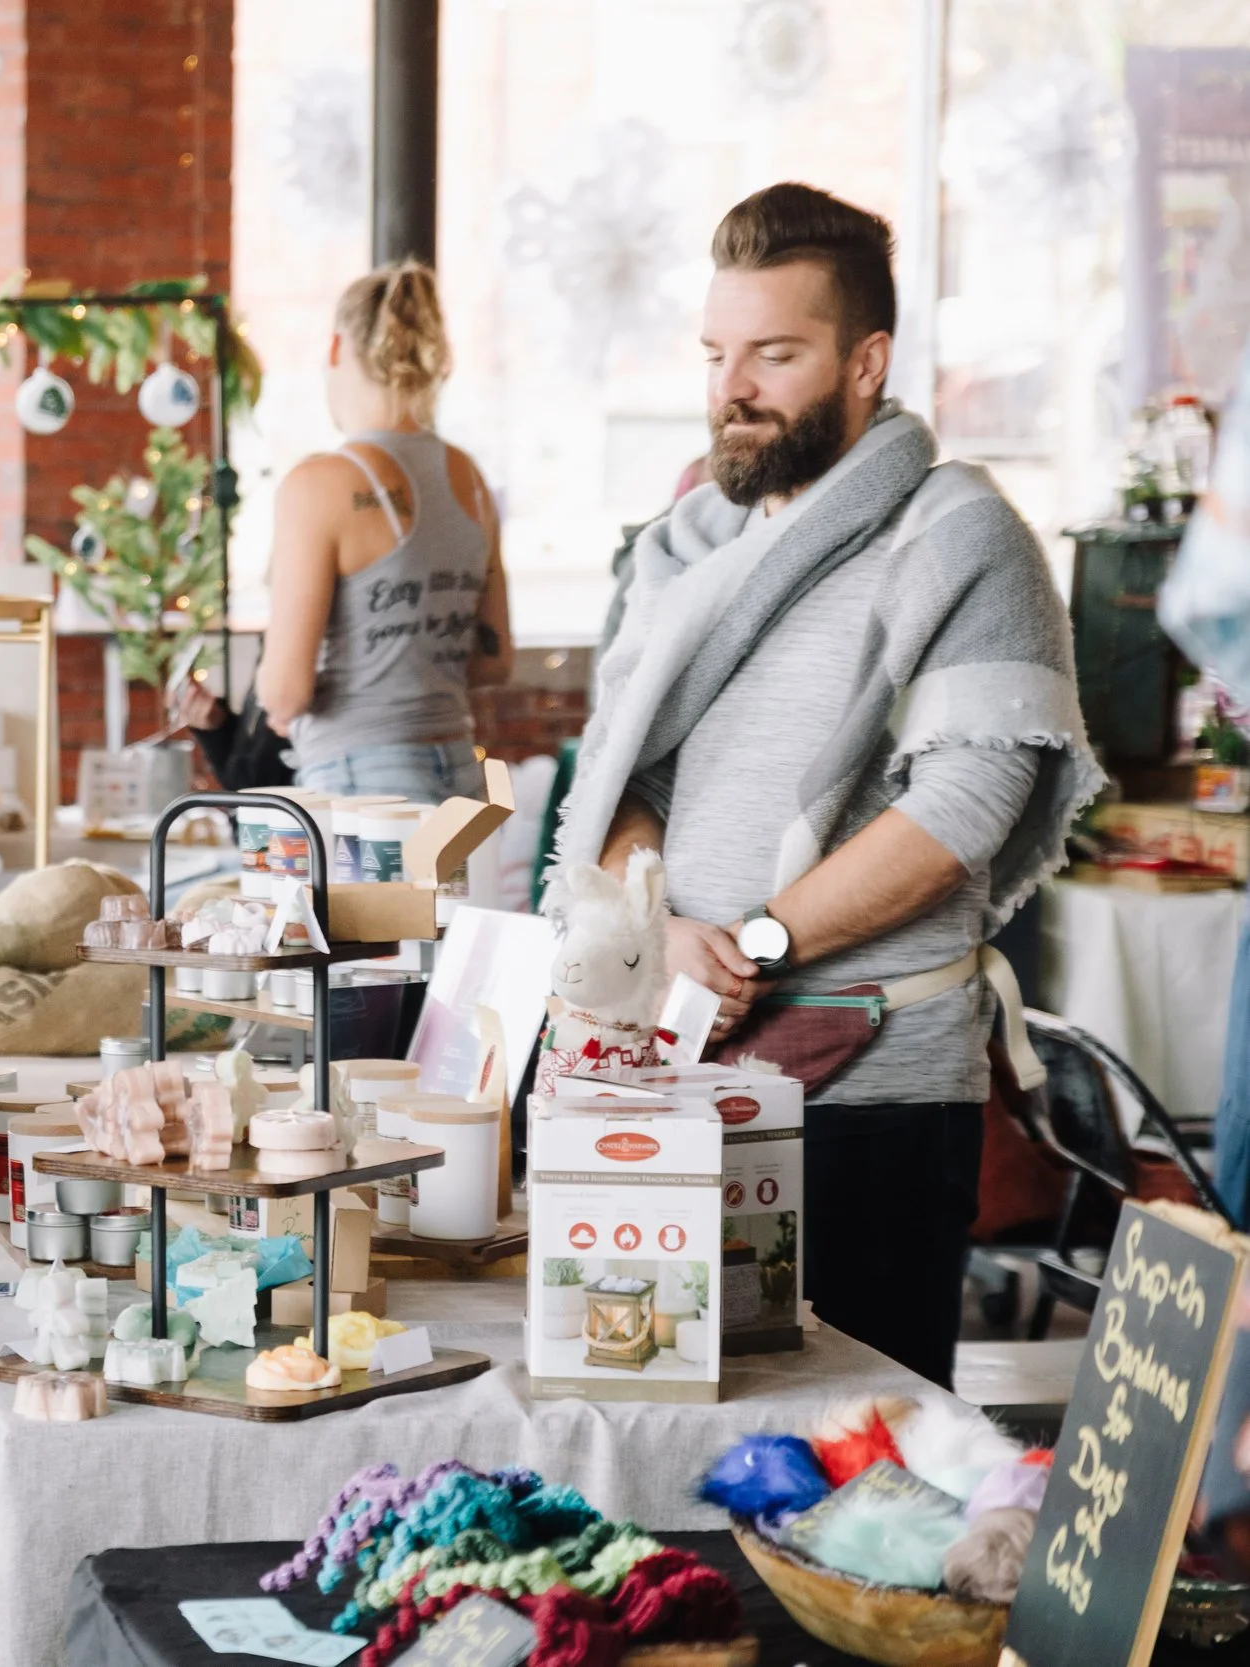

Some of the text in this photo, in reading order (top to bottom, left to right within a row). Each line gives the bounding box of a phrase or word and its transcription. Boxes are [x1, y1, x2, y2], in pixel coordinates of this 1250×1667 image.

[1094, 1297, 1190, 1424] Bandanas
[1101, 1381, 1134, 1446] for
[1068, 1424, 1129, 1525] Dogs
[1046, 1523, 1093, 1617] Cats
